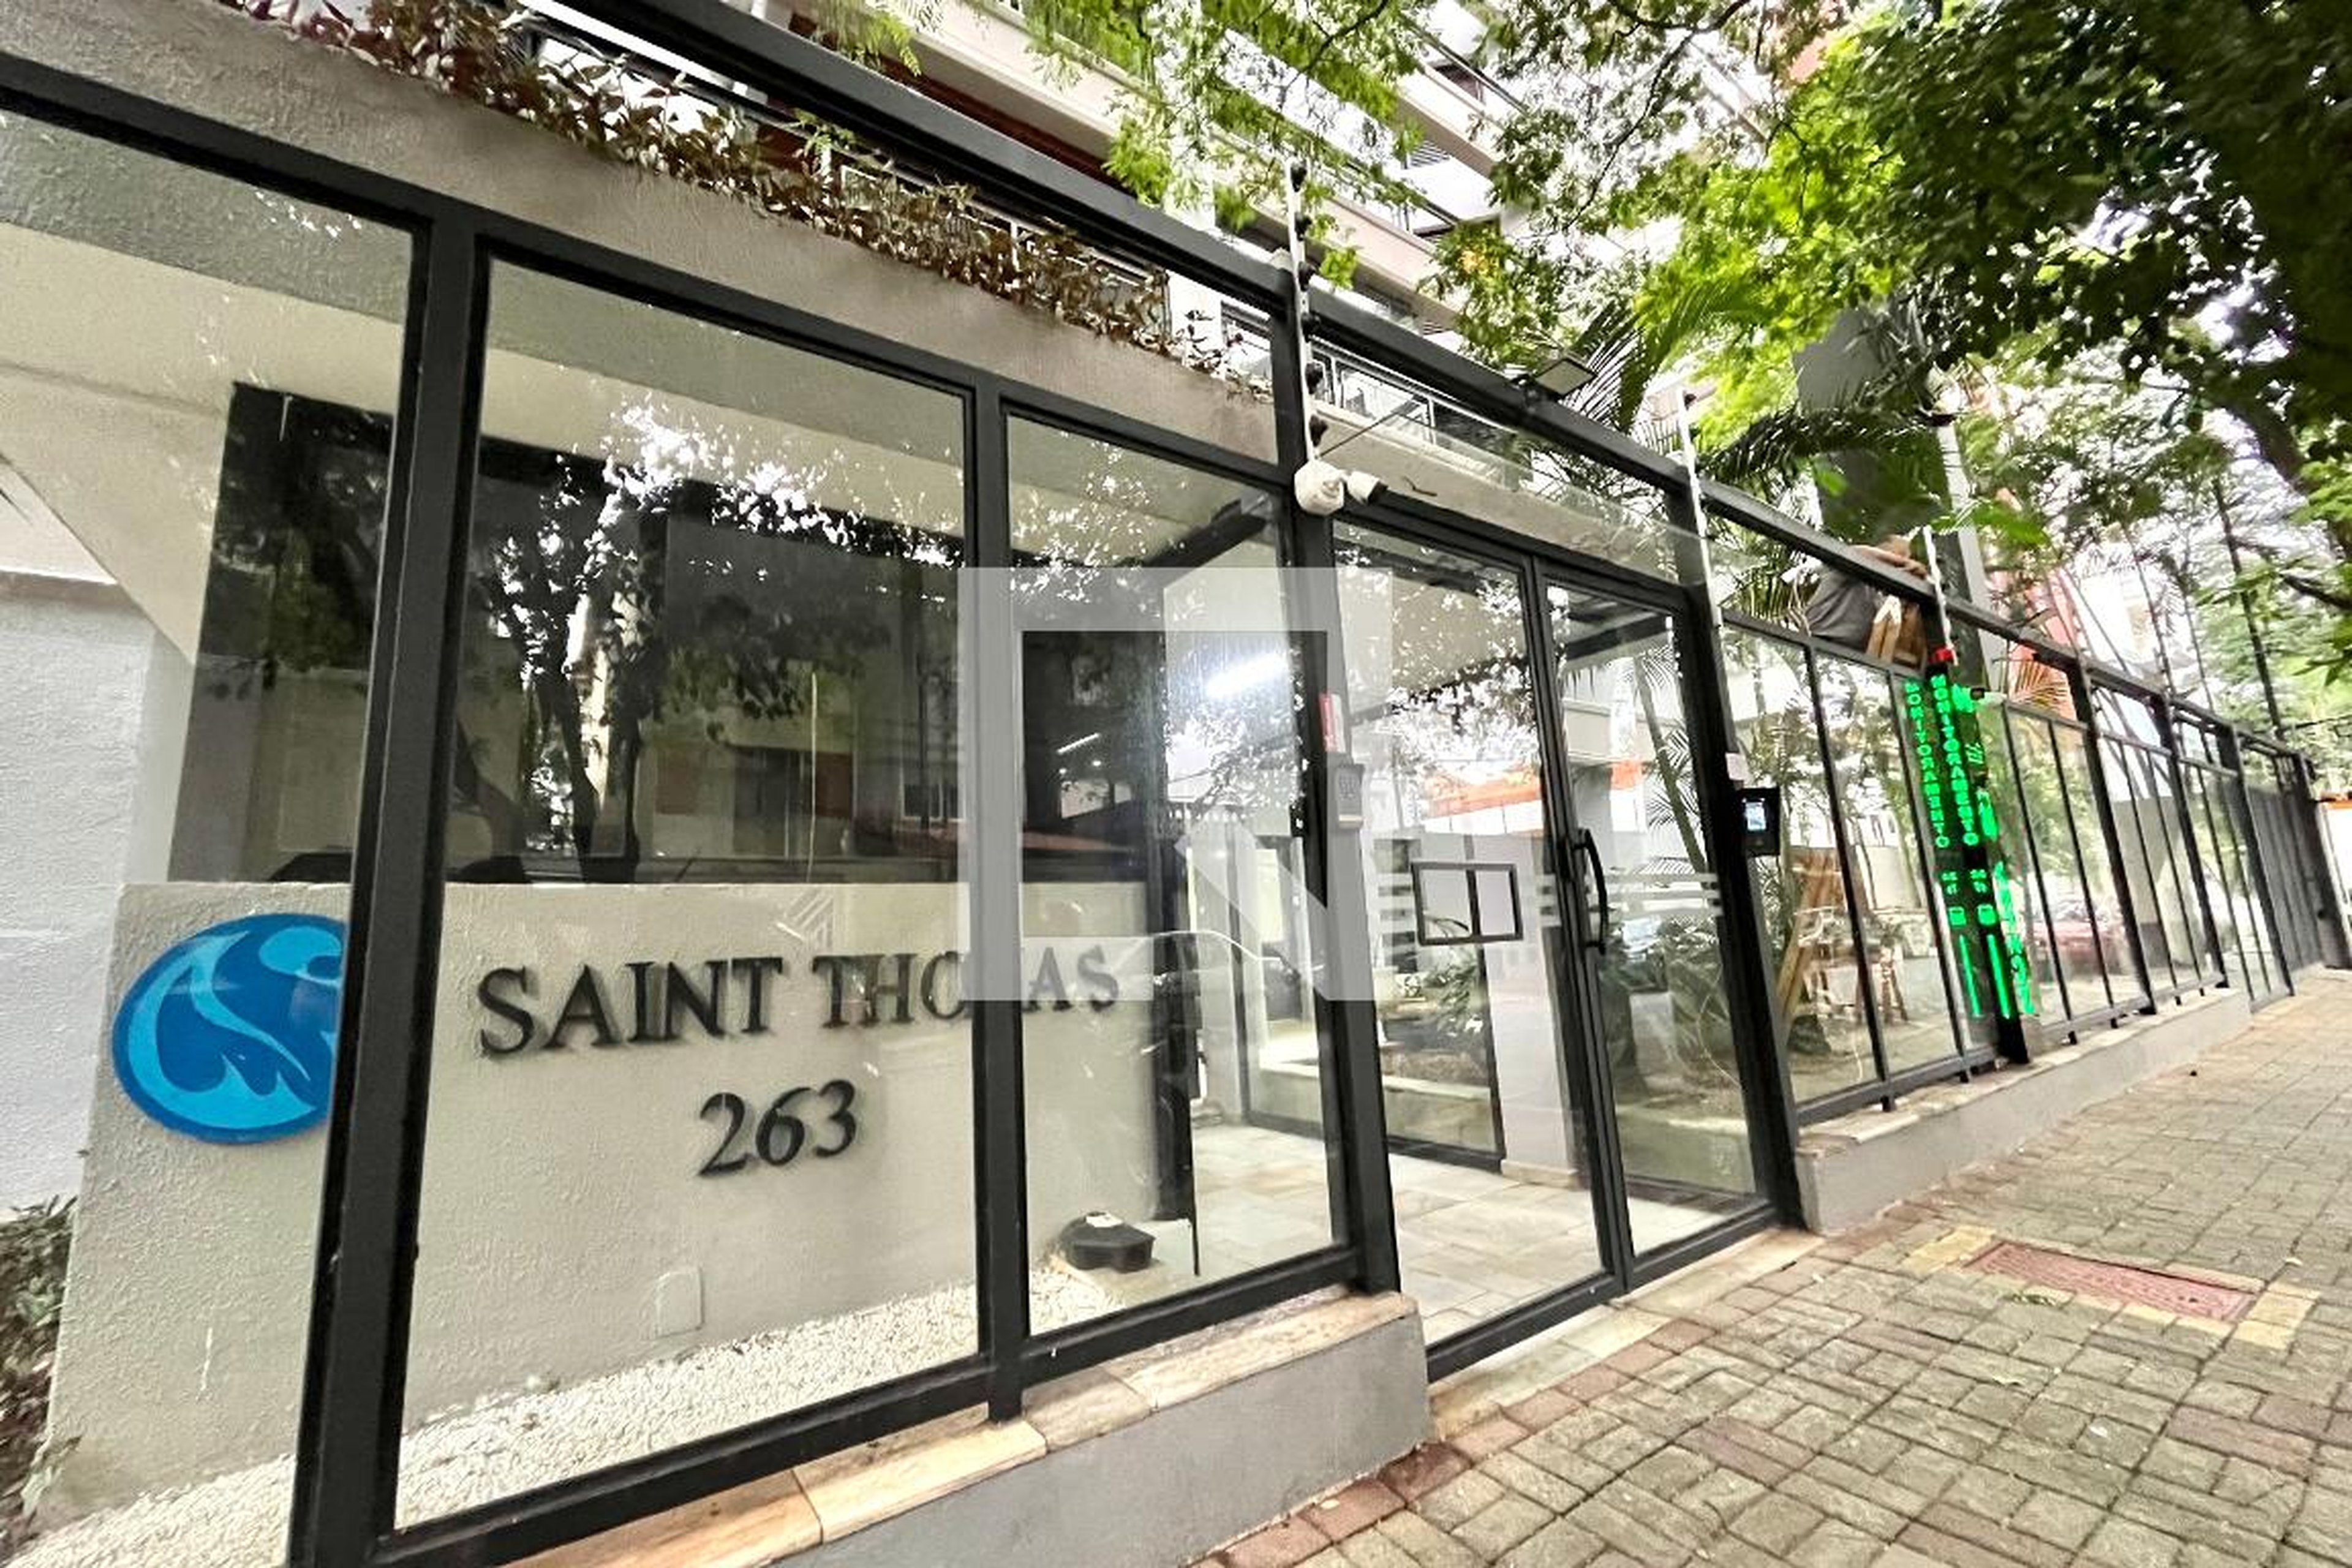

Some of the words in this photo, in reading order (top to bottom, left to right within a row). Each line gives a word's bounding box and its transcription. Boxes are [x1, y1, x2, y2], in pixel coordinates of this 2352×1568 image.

[477, 956, 784, 1056] SAINT
[812, 944, 1120, 1029] THOAS
[698, 1079, 858, 1179] 263
